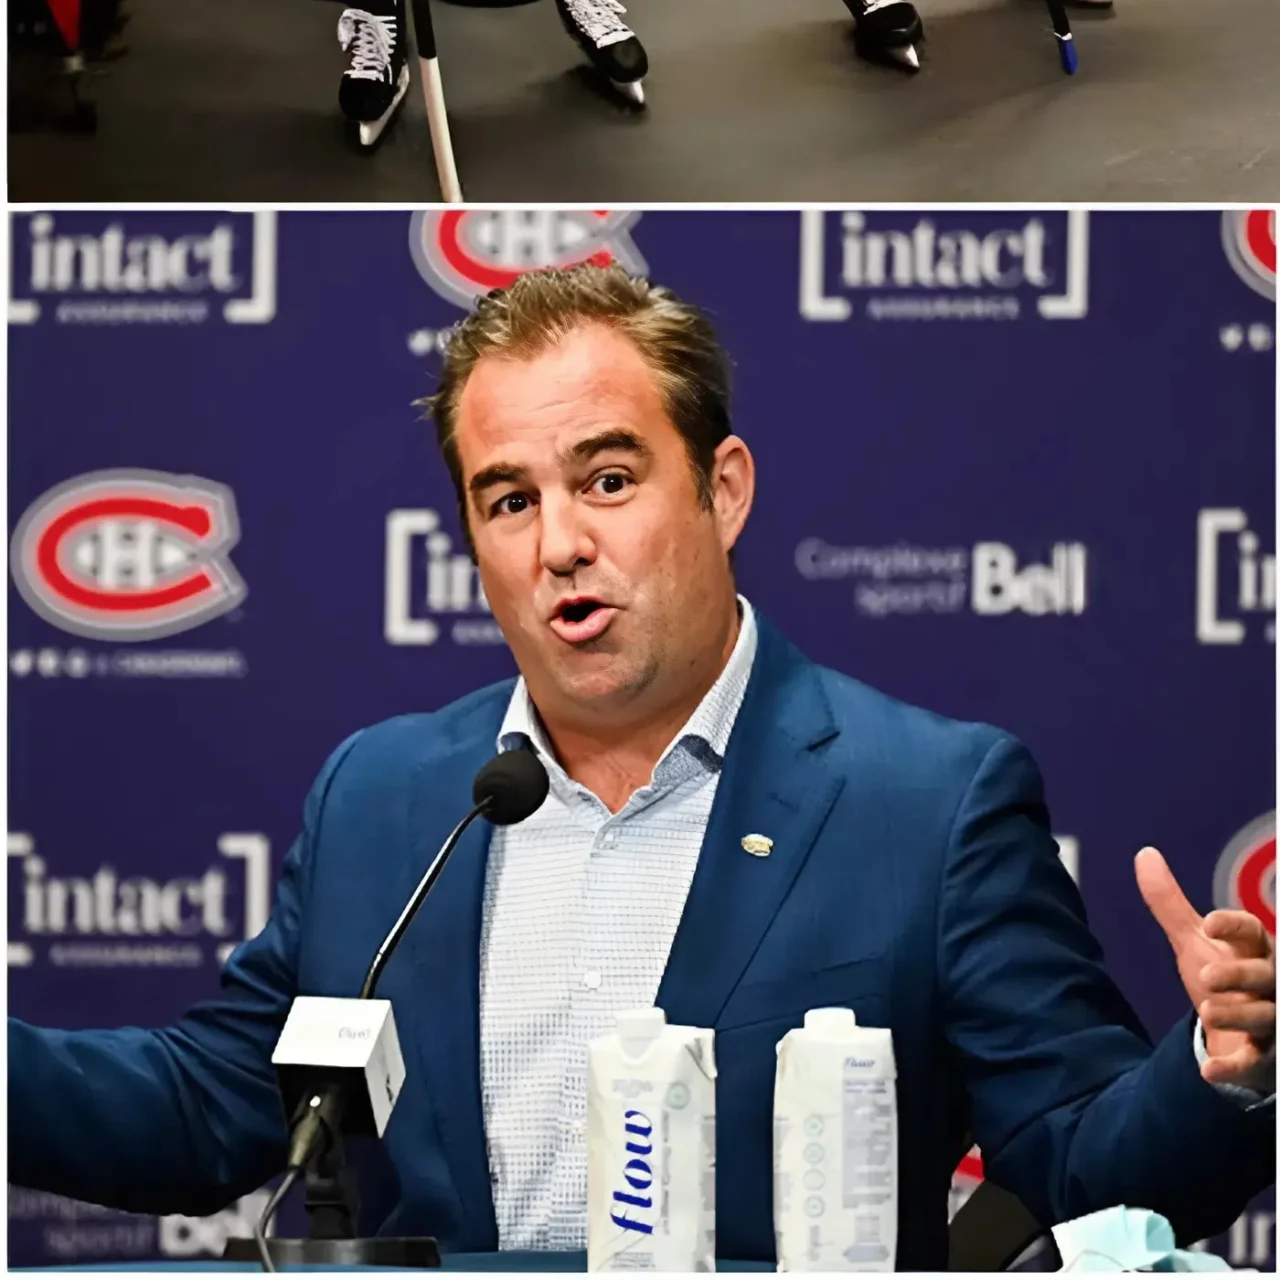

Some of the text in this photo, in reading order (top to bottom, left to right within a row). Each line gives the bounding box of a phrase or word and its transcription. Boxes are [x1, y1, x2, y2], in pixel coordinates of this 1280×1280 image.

[31, 213, 243, 293] intact
[840, 209, 1053, 288] intact
[972, 541, 1087, 616] Bell
[24, 854, 235, 936] intact
[610, 1109, 654, 1236] flow
